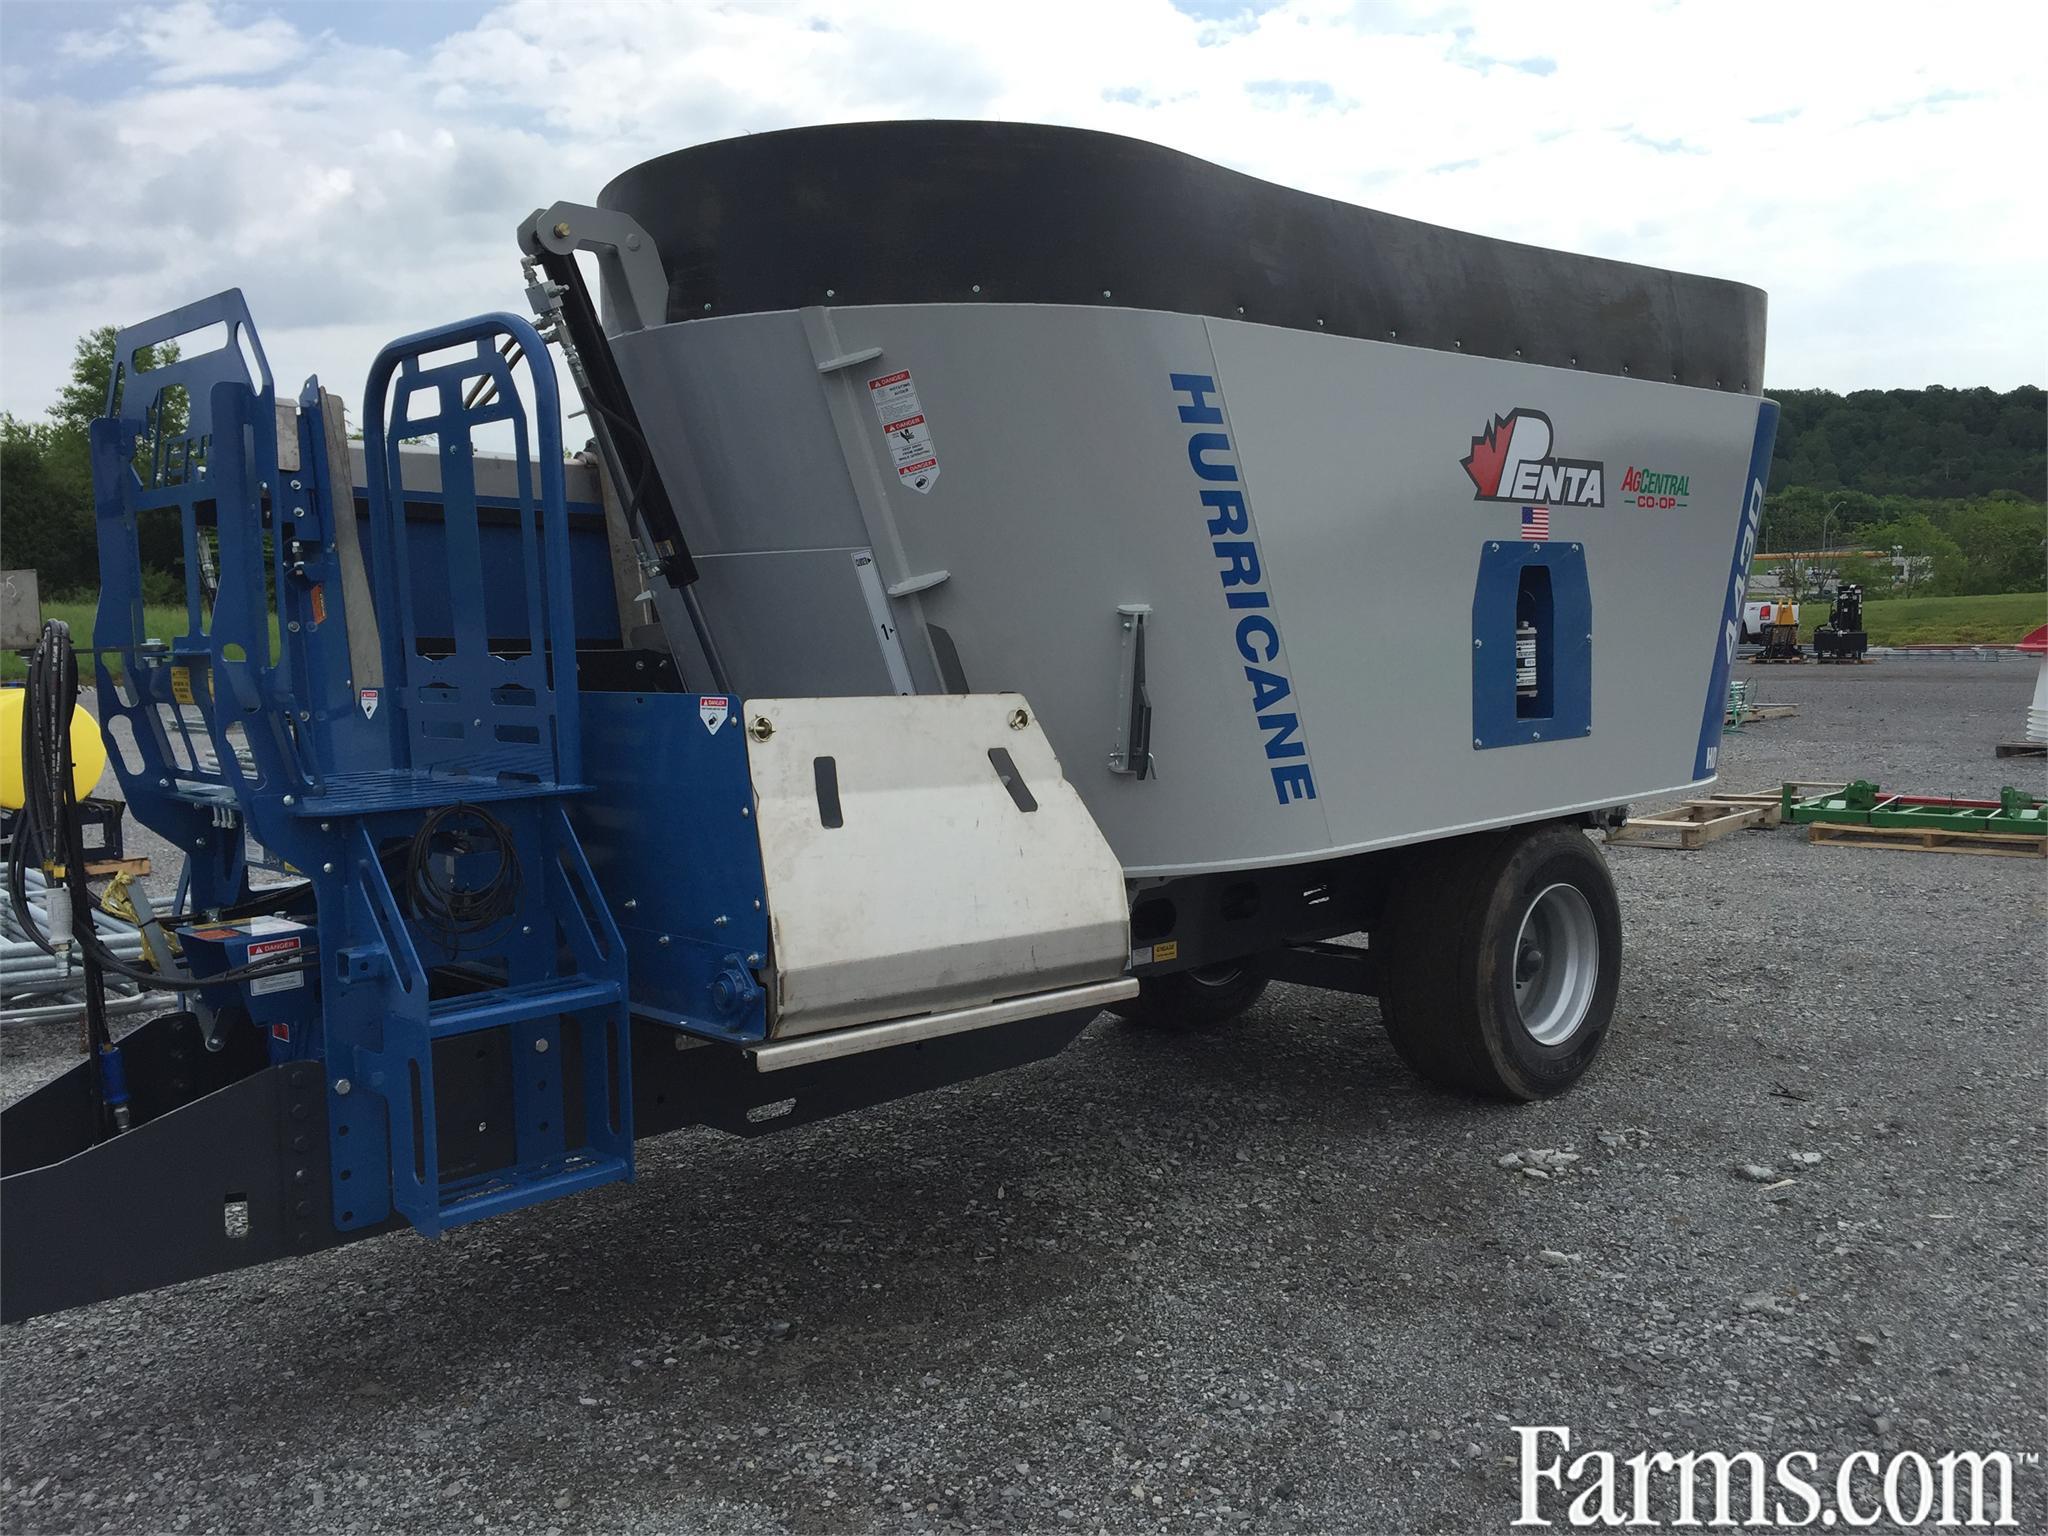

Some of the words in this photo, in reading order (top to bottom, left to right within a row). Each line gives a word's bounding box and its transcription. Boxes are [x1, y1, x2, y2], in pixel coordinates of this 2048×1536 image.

[881, 374, 906, 386] DANGER
[895, 418, 920, 429] DANGER
[1496, 414, 1602, 505] PENTA
[909, 460, 933, 472] DANGER
[1169, 373, 1317, 805] HURRICANE
[264, 941, 295, 952] DANGER
